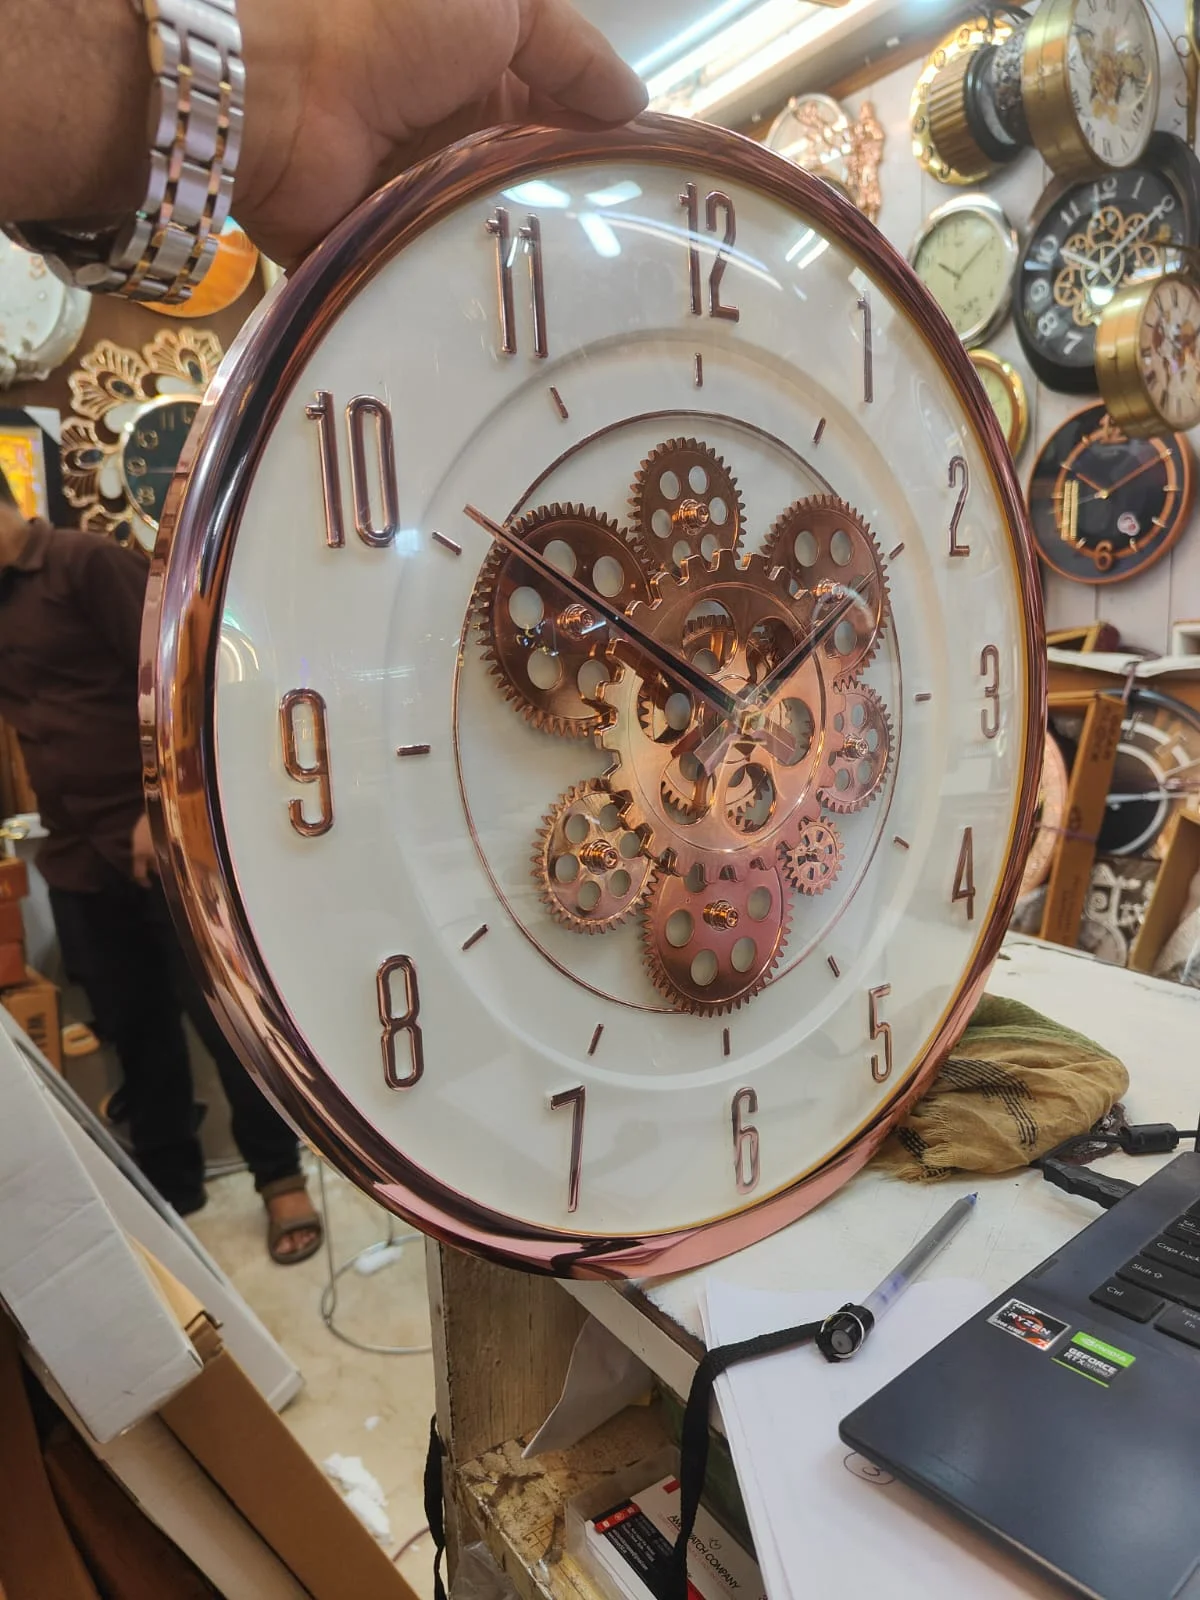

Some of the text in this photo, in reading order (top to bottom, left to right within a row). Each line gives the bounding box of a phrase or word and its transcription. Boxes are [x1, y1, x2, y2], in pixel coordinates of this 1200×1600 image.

[485, 206, 548, 359] 11
[679, 182, 739, 322] 12
[857, 289, 873, 403] 1
[1063, 331, 1083, 355] 7
[305, 390, 399, 549] 10
[948, 455, 971, 557] 2
[980, 644, 1001, 739] 3
[278, 687, 334, 838] 9
[952, 826, 976, 920] 4
[376, 954, 424, 1091] 8
[868, 983, 893, 1083] 5
[550, 1085, 586, 1213] 7
[731, 1086, 761, 1194] 6
[1106, 1286, 1124, 1297] Ctrl
[1131, 1263, 1152, 1276] Shift
[1156, 1242, 1179, 1254] Caps
[1008, 1310, 1051, 1336] RYZEN
[1063, 1350, 1086, 1366] RTX
[1068, 1347, 1118, 1375] GEFORCE
[705, 1552, 740, 1589] COMPANY
